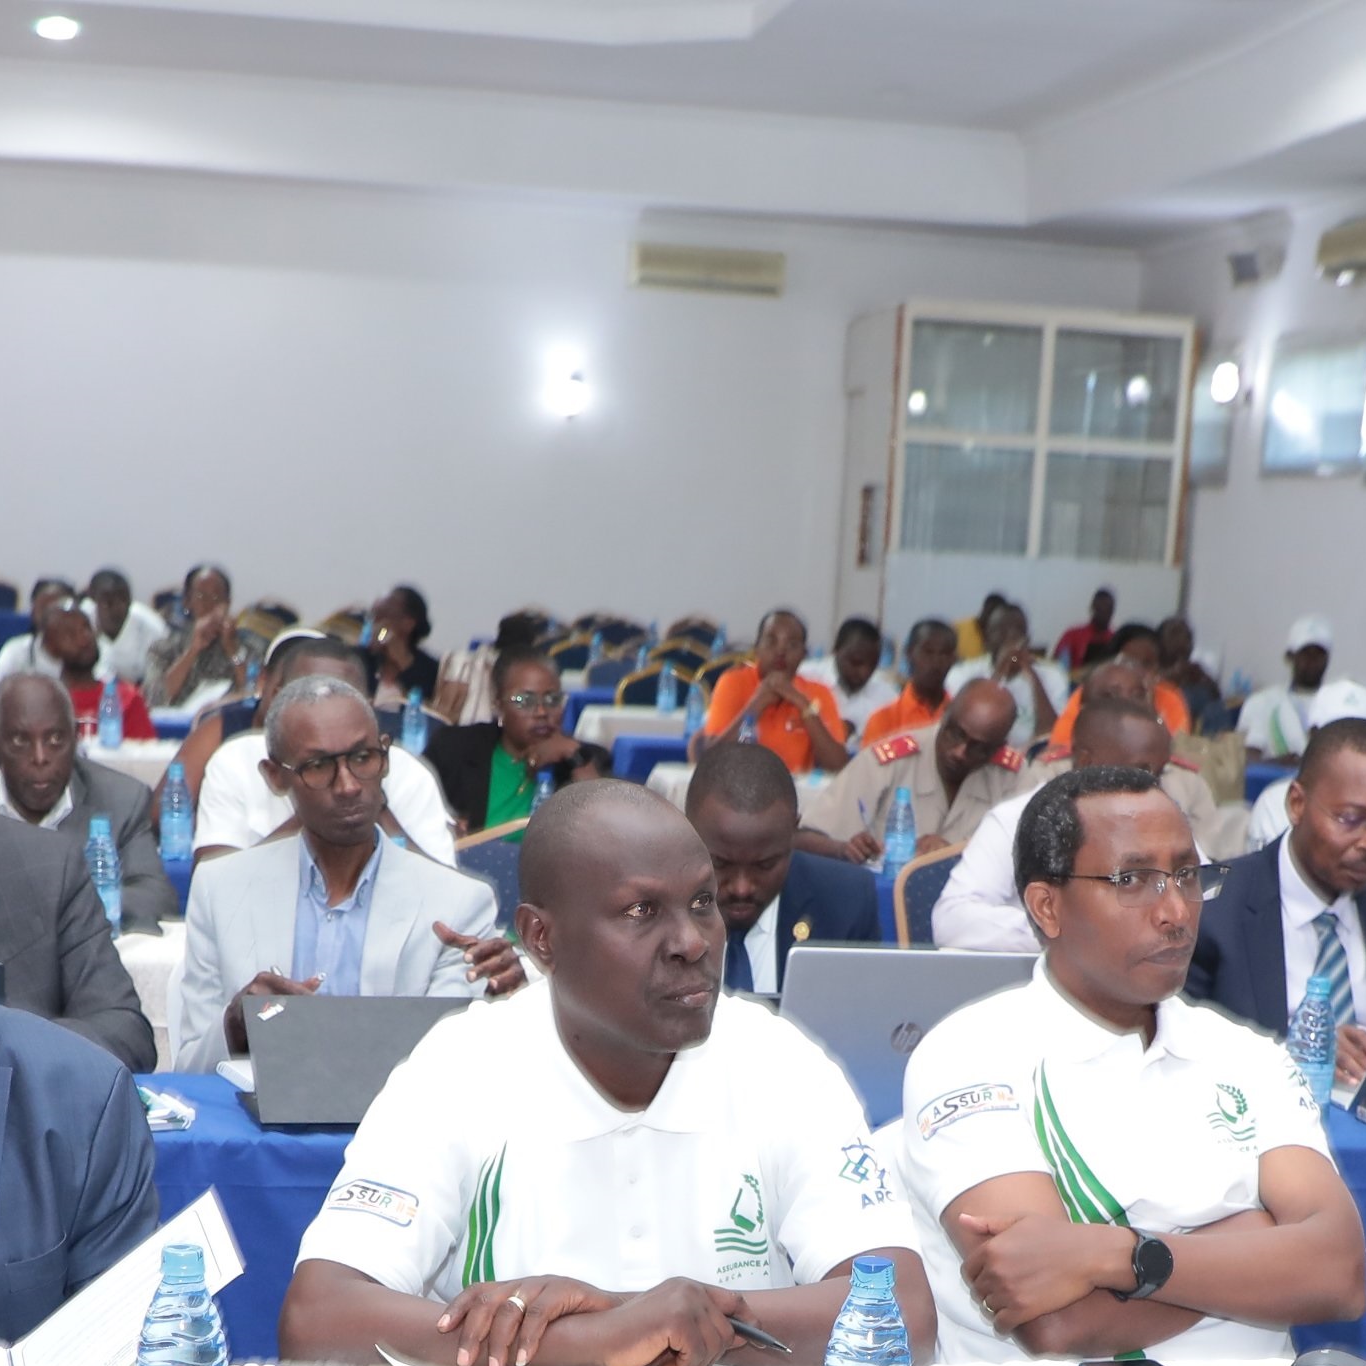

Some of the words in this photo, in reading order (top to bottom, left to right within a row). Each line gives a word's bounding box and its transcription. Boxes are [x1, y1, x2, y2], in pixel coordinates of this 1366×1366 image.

[893, 1021, 921, 1055] hp
[335, 1184, 392, 1208] SSUR
[716, 1260, 761, 1274] ASSURANCE
